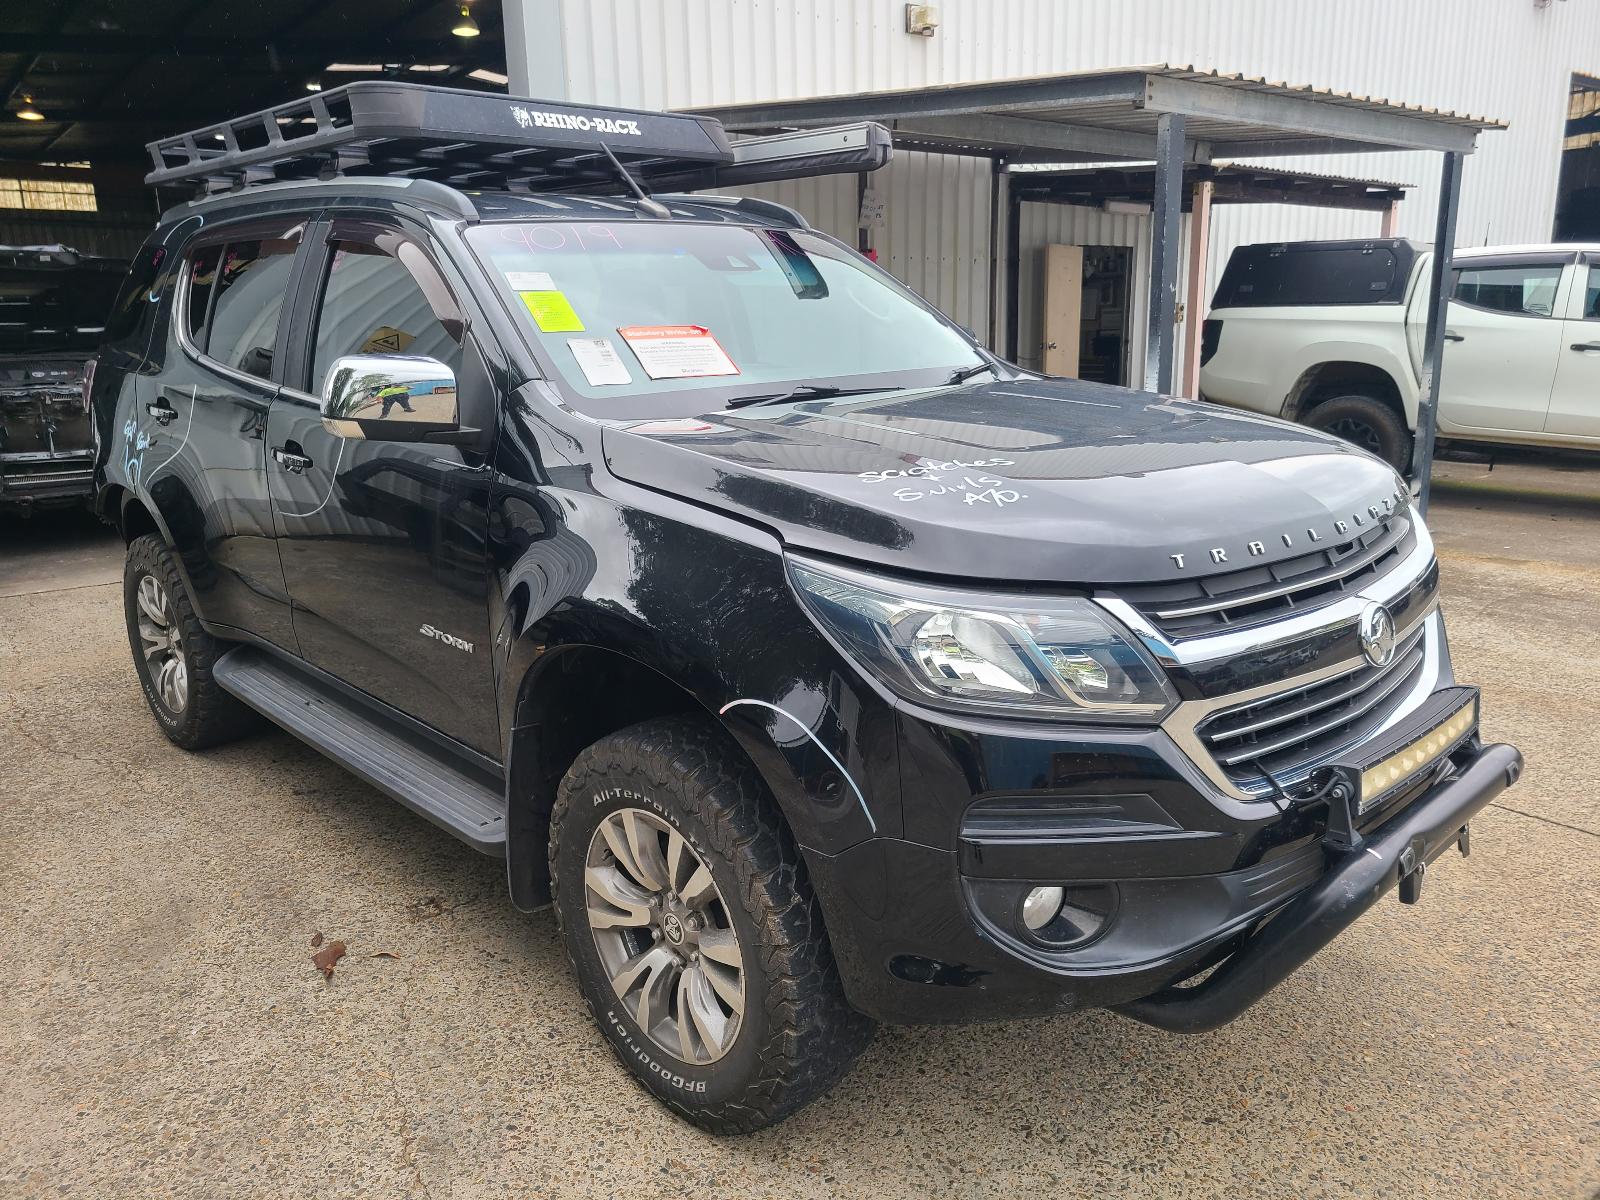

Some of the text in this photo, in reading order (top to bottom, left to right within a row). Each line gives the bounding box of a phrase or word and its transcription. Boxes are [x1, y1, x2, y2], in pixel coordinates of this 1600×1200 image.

[531, 111, 642, 136] RHINO-RACK
[1169, 491, 1403, 569] TRAILBLAZE
[419, 623, 474, 654] STORM
[593, 787, 680, 827] All-Terrain
[607, 1011, 706, 1093] BFGoodrich
